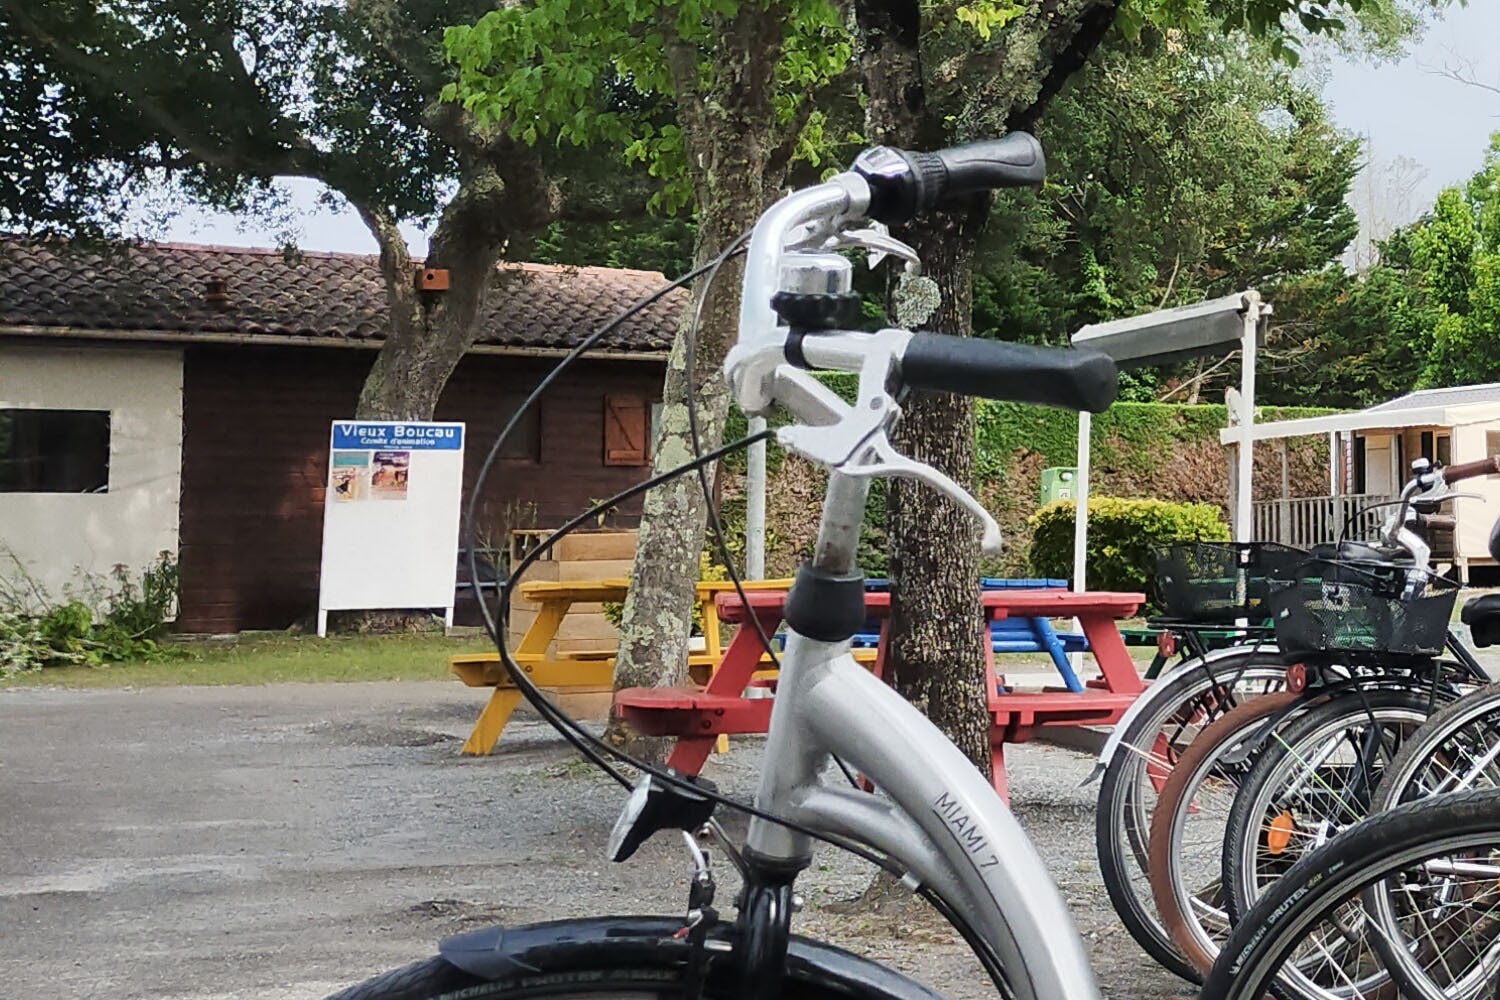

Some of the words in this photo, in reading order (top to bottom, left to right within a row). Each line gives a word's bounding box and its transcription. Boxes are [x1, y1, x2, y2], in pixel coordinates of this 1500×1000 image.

[341, 424, 386, 437] Vieux
[394, 425, 454, 438] Boucau
[934, 791, 988, 854] MIAMI
[980, 854, 999, 868] 7
